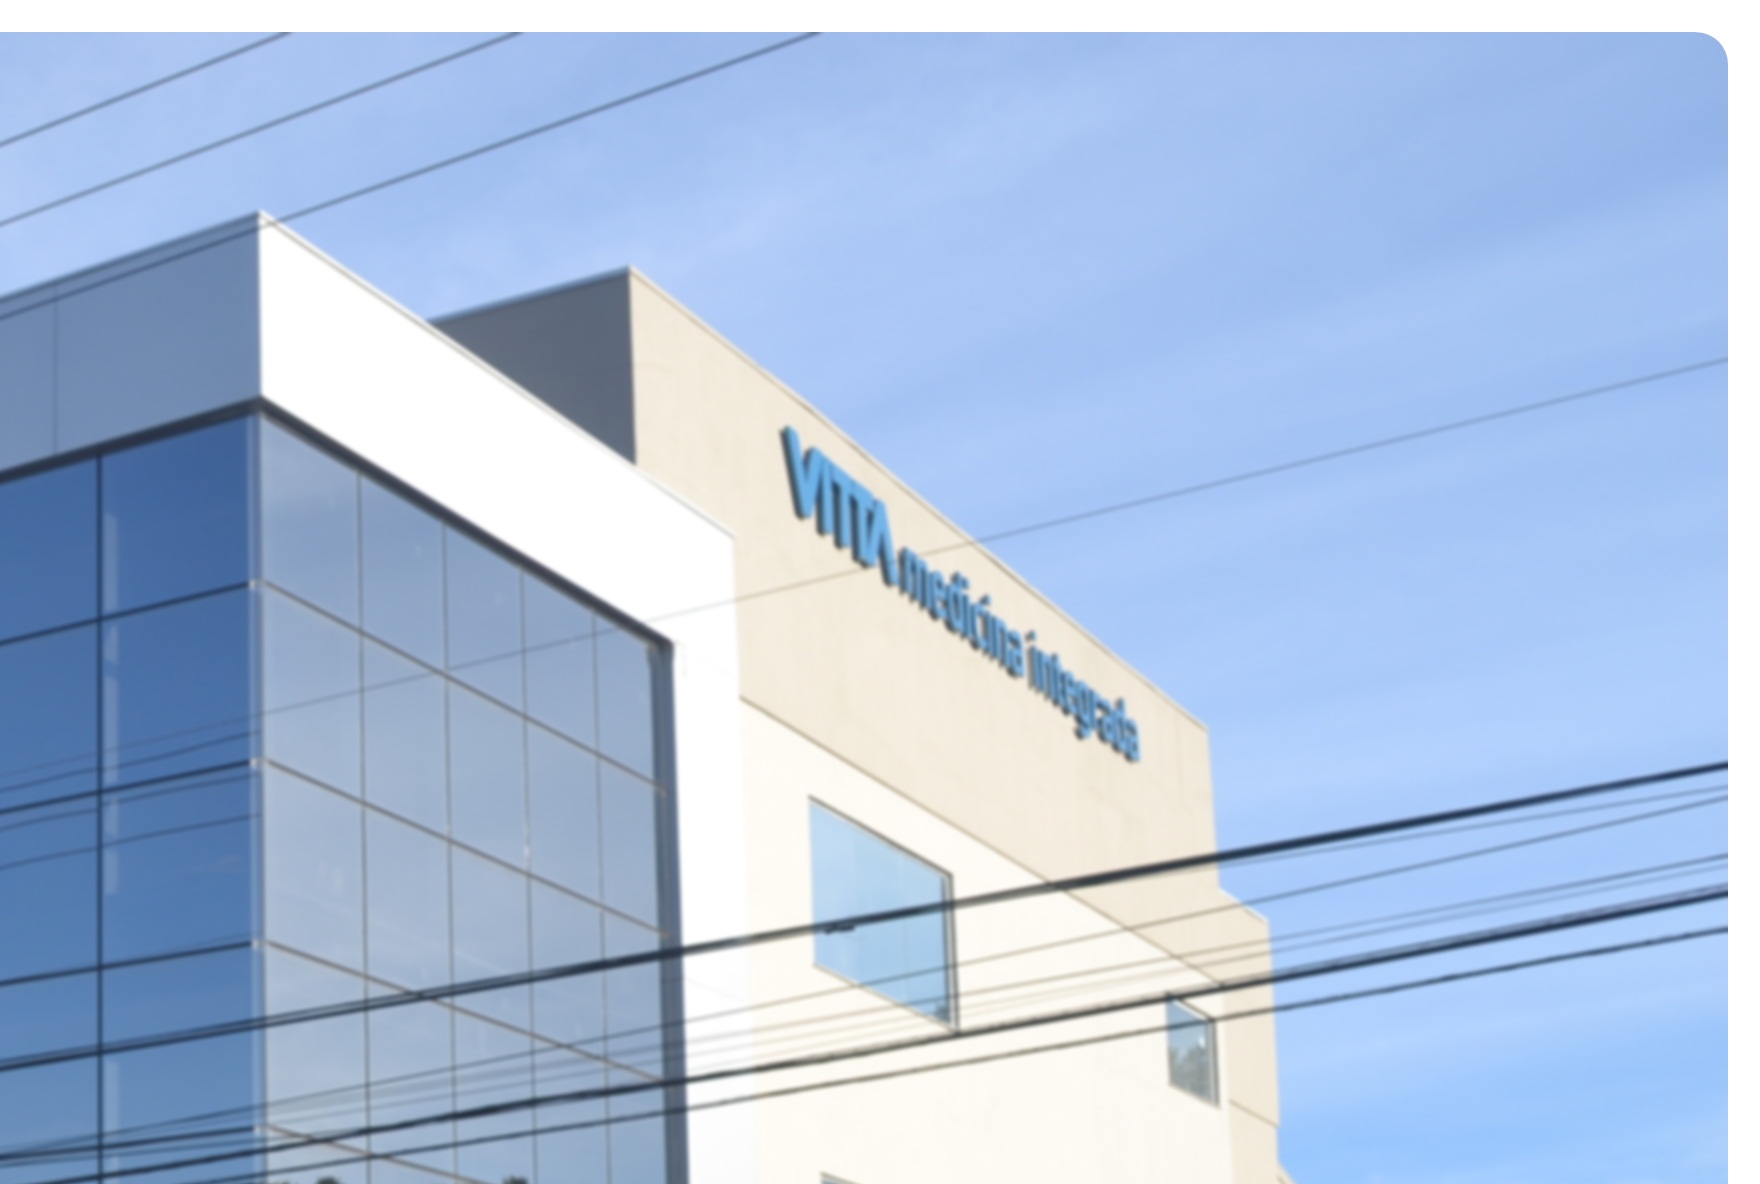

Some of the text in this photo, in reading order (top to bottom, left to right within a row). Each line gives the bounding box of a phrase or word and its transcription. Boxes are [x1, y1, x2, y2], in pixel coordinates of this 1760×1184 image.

[780, 426, 1140, 762] VITTA medicina integrada
